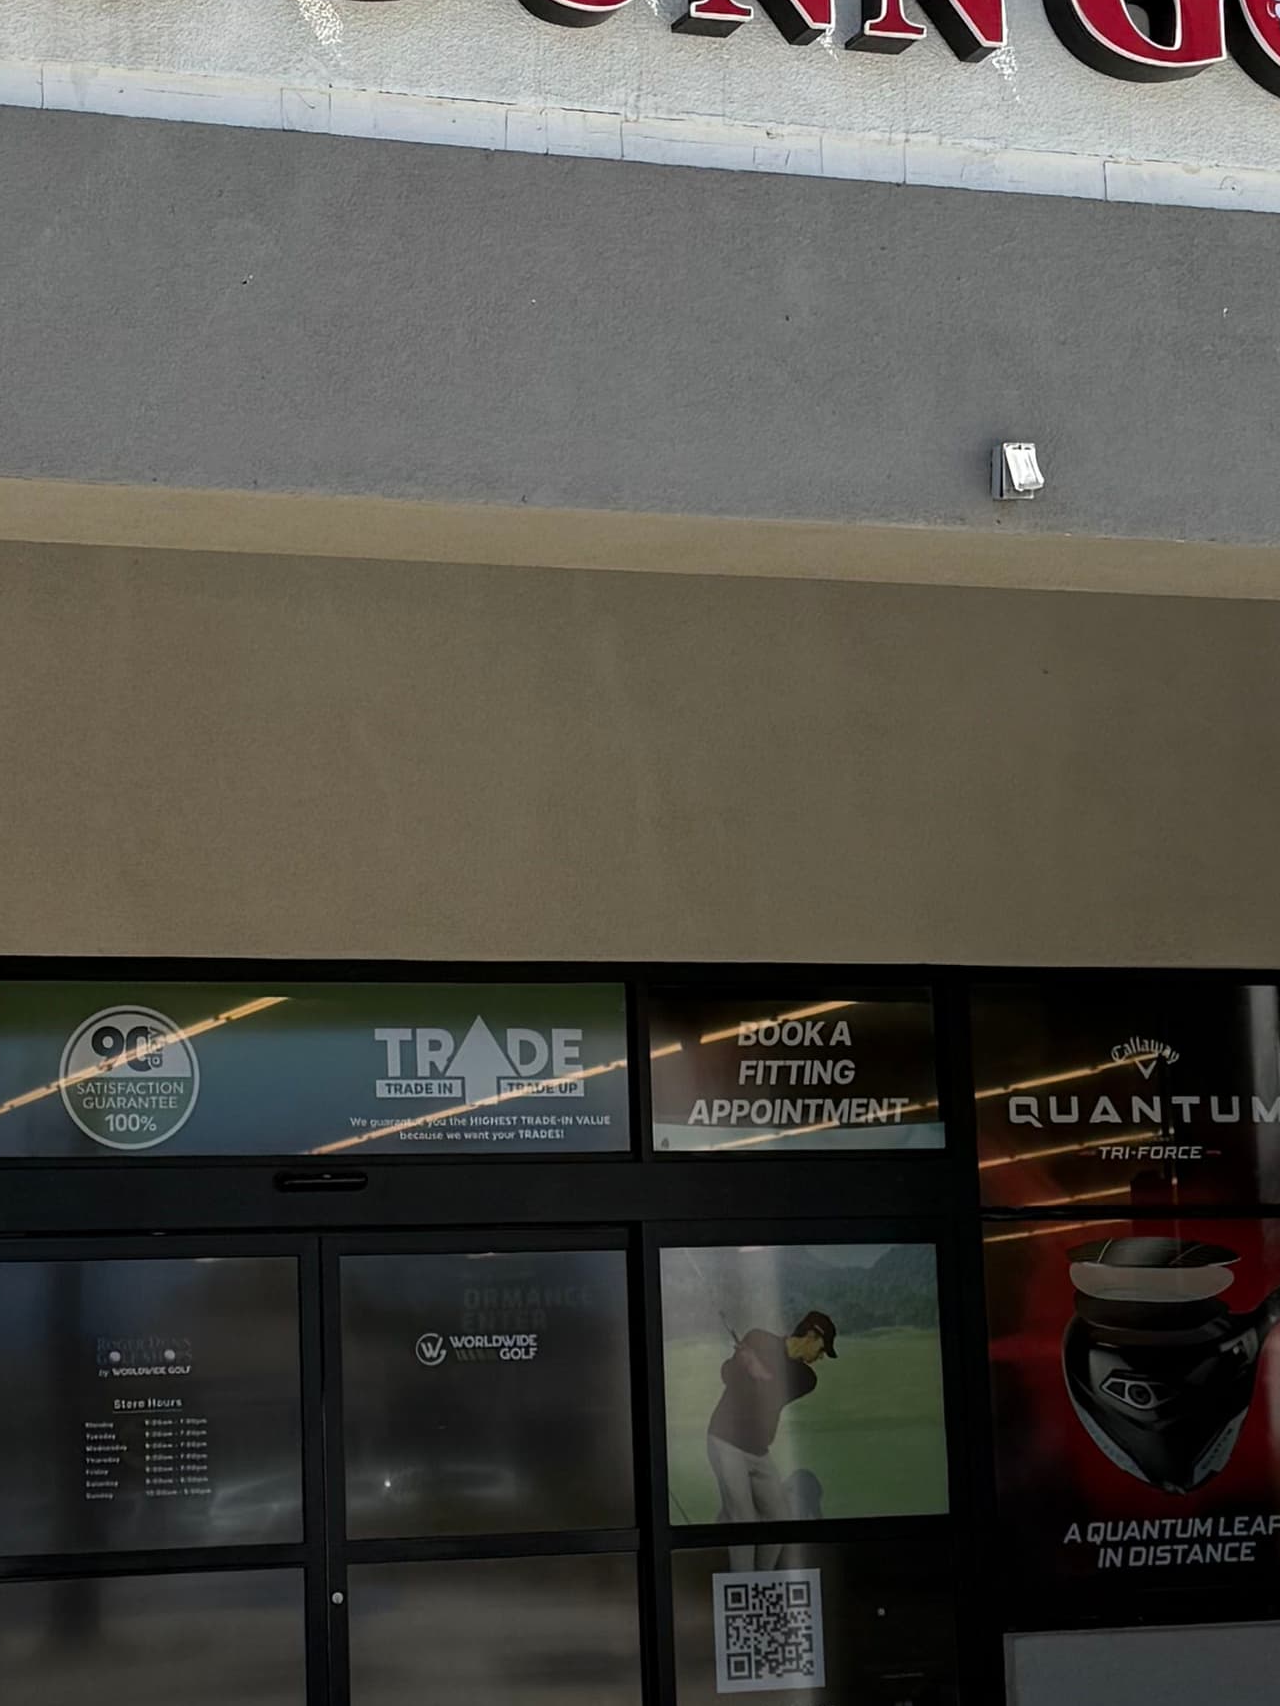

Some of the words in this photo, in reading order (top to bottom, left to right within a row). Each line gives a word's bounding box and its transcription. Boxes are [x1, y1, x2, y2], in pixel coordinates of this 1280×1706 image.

[737, 1020, 825, 1047] BOOK
[829, 1020, 853, 1047] A
[91, 1026, 152, 1072] 90
[374, 1017, 584, 1079] TRADE
[1111, 1036, 1180, 1065] Callaway
[738, 1059, 856, 1086] FITTING
[76, 1081, 185, 1096] SATISFACTION
[385, 1082, 431, 1095] TRADE
[437, 1082, 454, 1094] IN
[506, 1082, 554, 1095] TRADE
[558, 1082, 579, 1094] UP
[82, 1096, 179, 1110] GUARANTEE
[687, 1096, 910, 1125] APPOINTMENT
[104, 1113, 158, 1133] 100%
[349, 1116, 367, 1127] We
[369, 1116, 424, 1130] guarane
[427, 1116, 446, 1131] you
[448, 1115, 468, 1127] the
[469, 1114, 518, 1127] HIGHEST
[521, 1114, 573, 1126] TRADE-IN
[575, 1114, 611, 1126] VALUE
[399, 1129, 444, 1141] because
[446, 1131, 462, 1141] we
[463, 1129, 489, 1141] want
[491, 1130, 516, 1143] your
[517, 1127, 565, 1140] TRADES!
[1098, 1145, 1204, 1160] TRI-FORCE
[448, 1334, 539, 1350] WORLDWIDE
[499, 1347, 539, 1361] GOLF
[1063, 1522, 1082, 1545] A
[1086, 1516, 1213, 1545] QUANTUM
[1097, 1547, 1123, 1569] IN
[1128, 1541, 1257, 1568] DISTANCE
